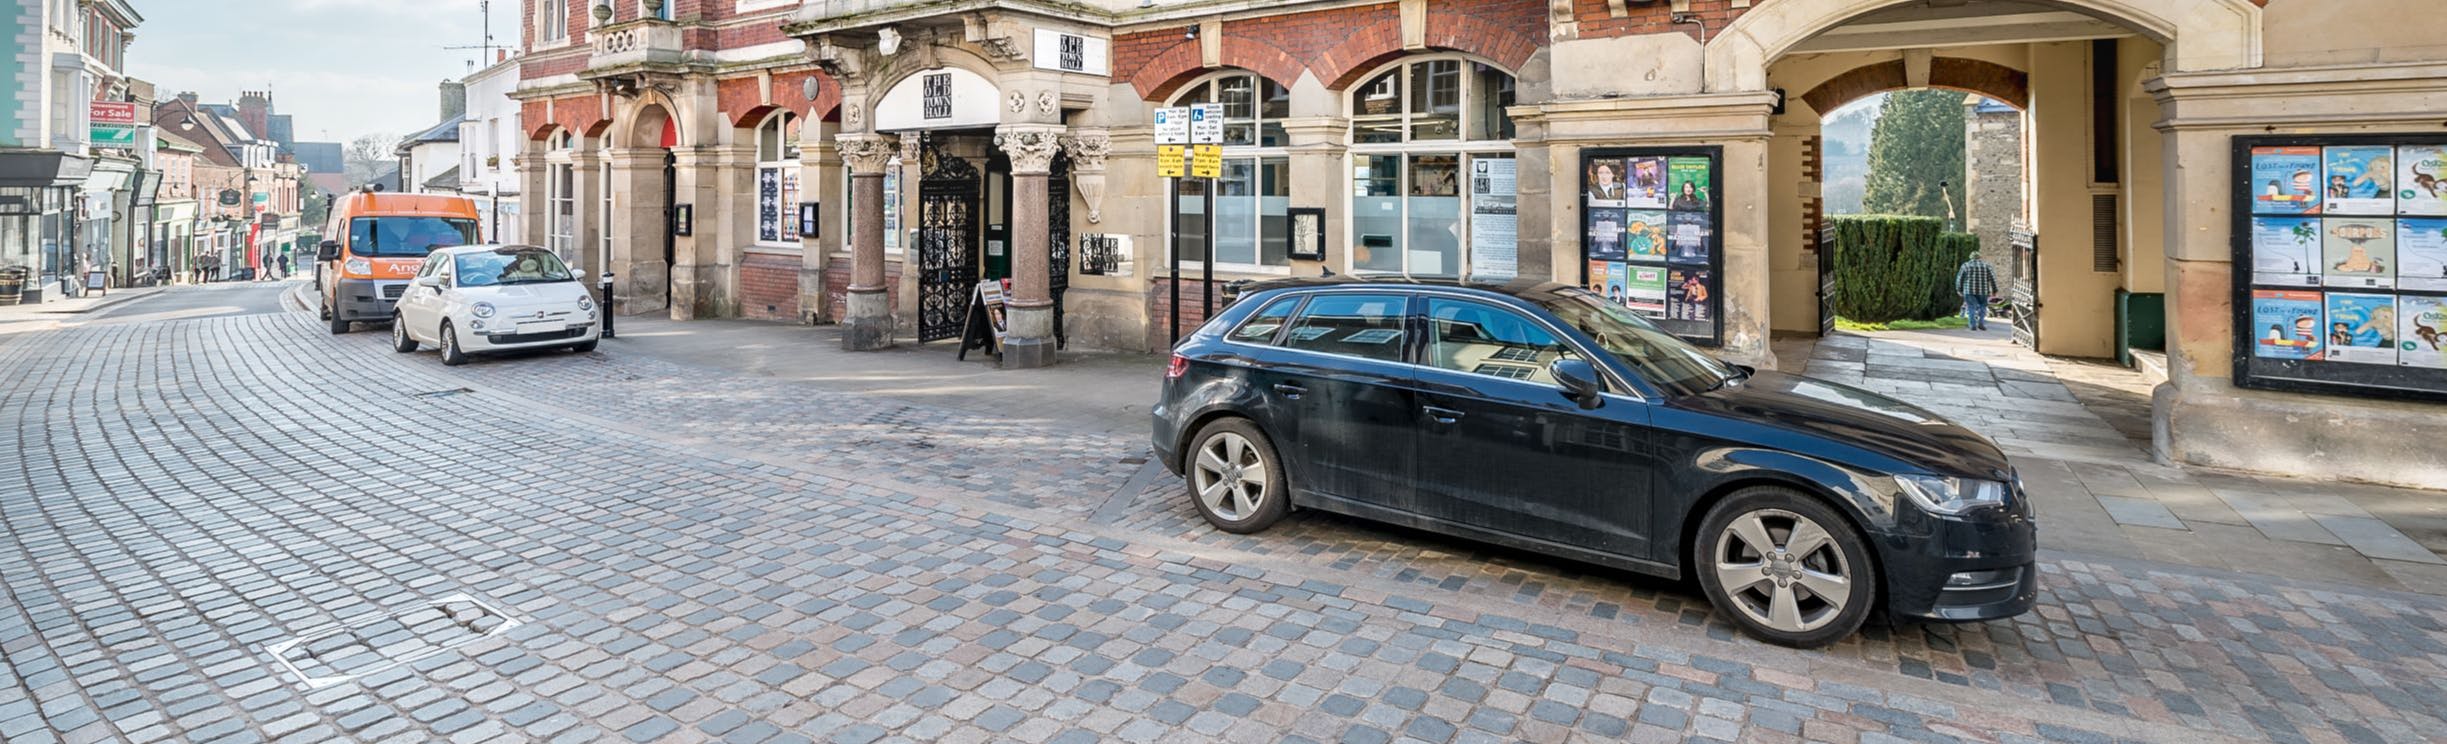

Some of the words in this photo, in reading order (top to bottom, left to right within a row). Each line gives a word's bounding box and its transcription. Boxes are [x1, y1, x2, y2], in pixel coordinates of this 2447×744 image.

[1061, 36, 1083, 45] THE
[1061, 44, 1083, 53] OLD
[1061, 52, 1083, 61] TOWN
[1061, 60, 1083, 69] HALL
[924, 74, 951, 86] THE
[924, 85, 951, 97] OLD
[924, 96, 951, 107] TOWN
[107, 109, 132, 118] Sale
[925, 106, 951, 118] HALL
[388, 263, 421, 275] Ang
